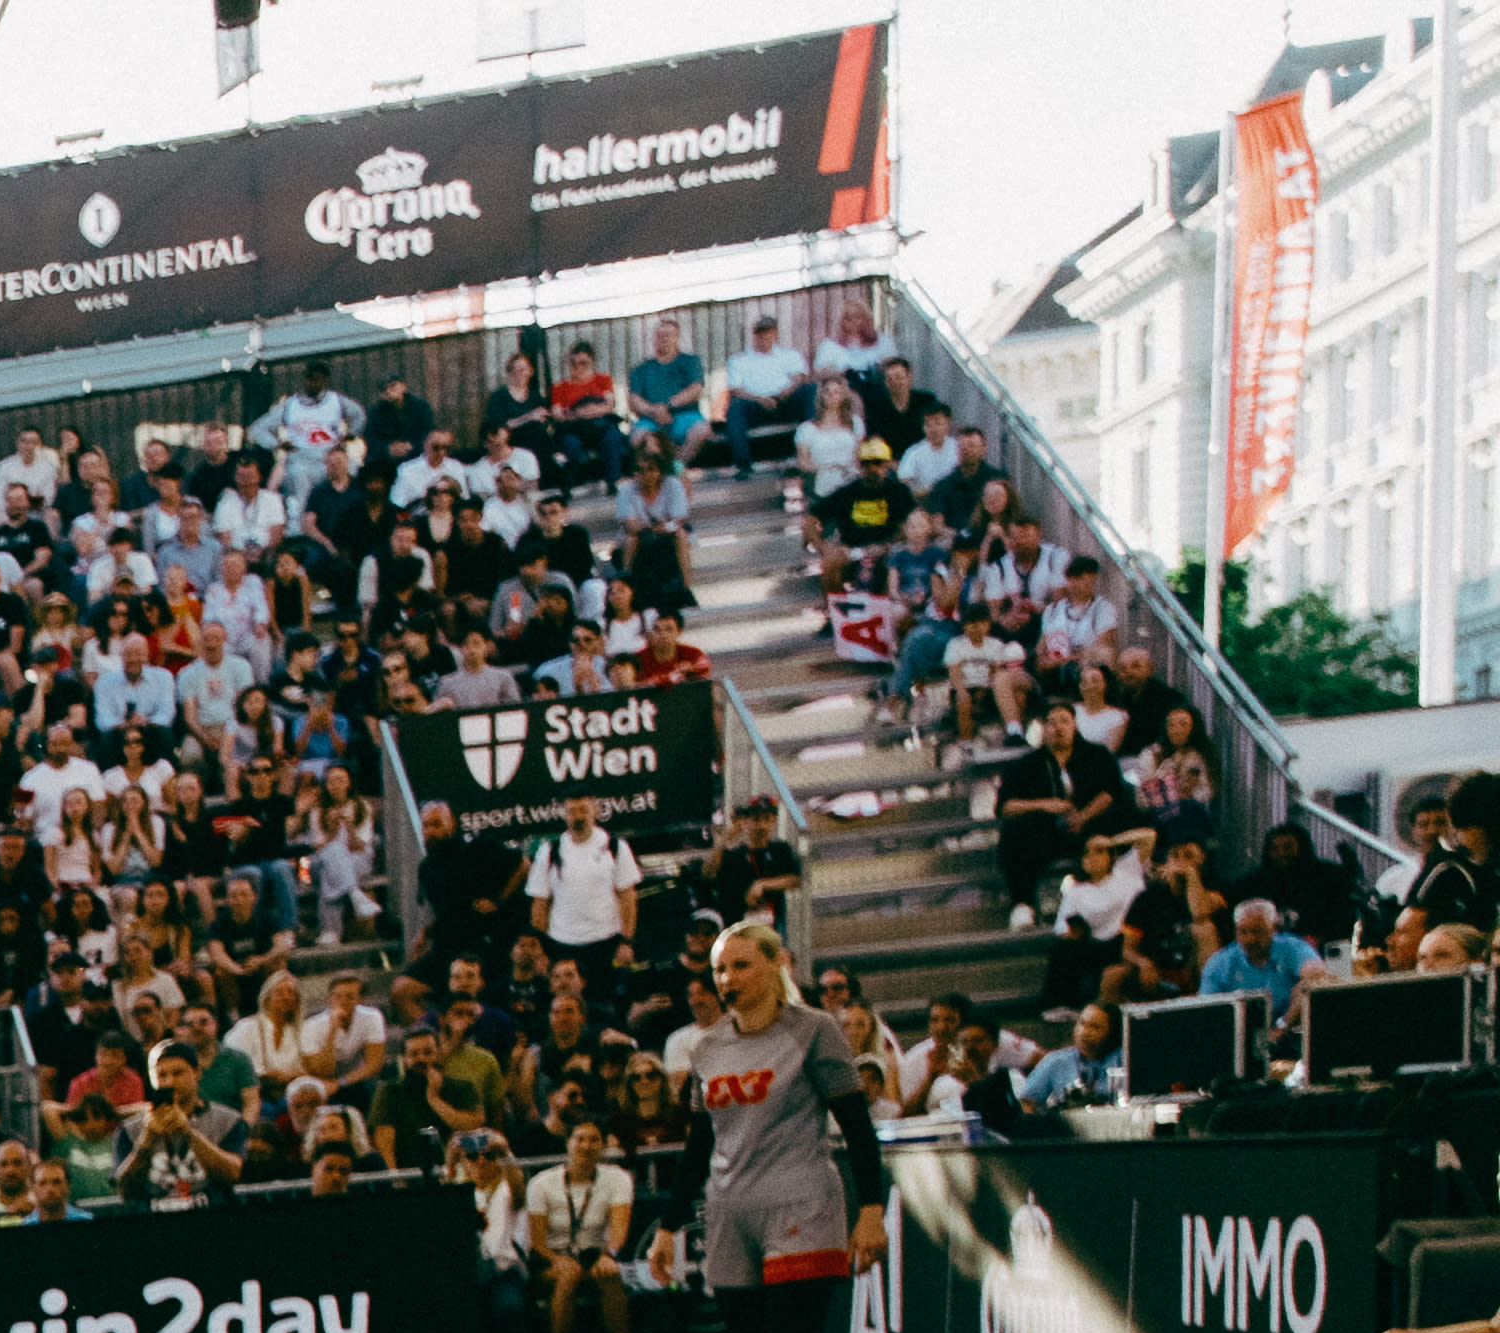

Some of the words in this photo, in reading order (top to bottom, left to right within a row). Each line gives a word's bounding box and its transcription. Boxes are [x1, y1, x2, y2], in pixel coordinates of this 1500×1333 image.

[532, 105, 784, 187] hallermobil
[304, 177, 482, 248] Corona
[356, 225, 435, 265] Cero
[76, 291, 130, 313] WIEN
[544, 695, 659, 745] Stadt
[544, 739, 659, 783] Wien
